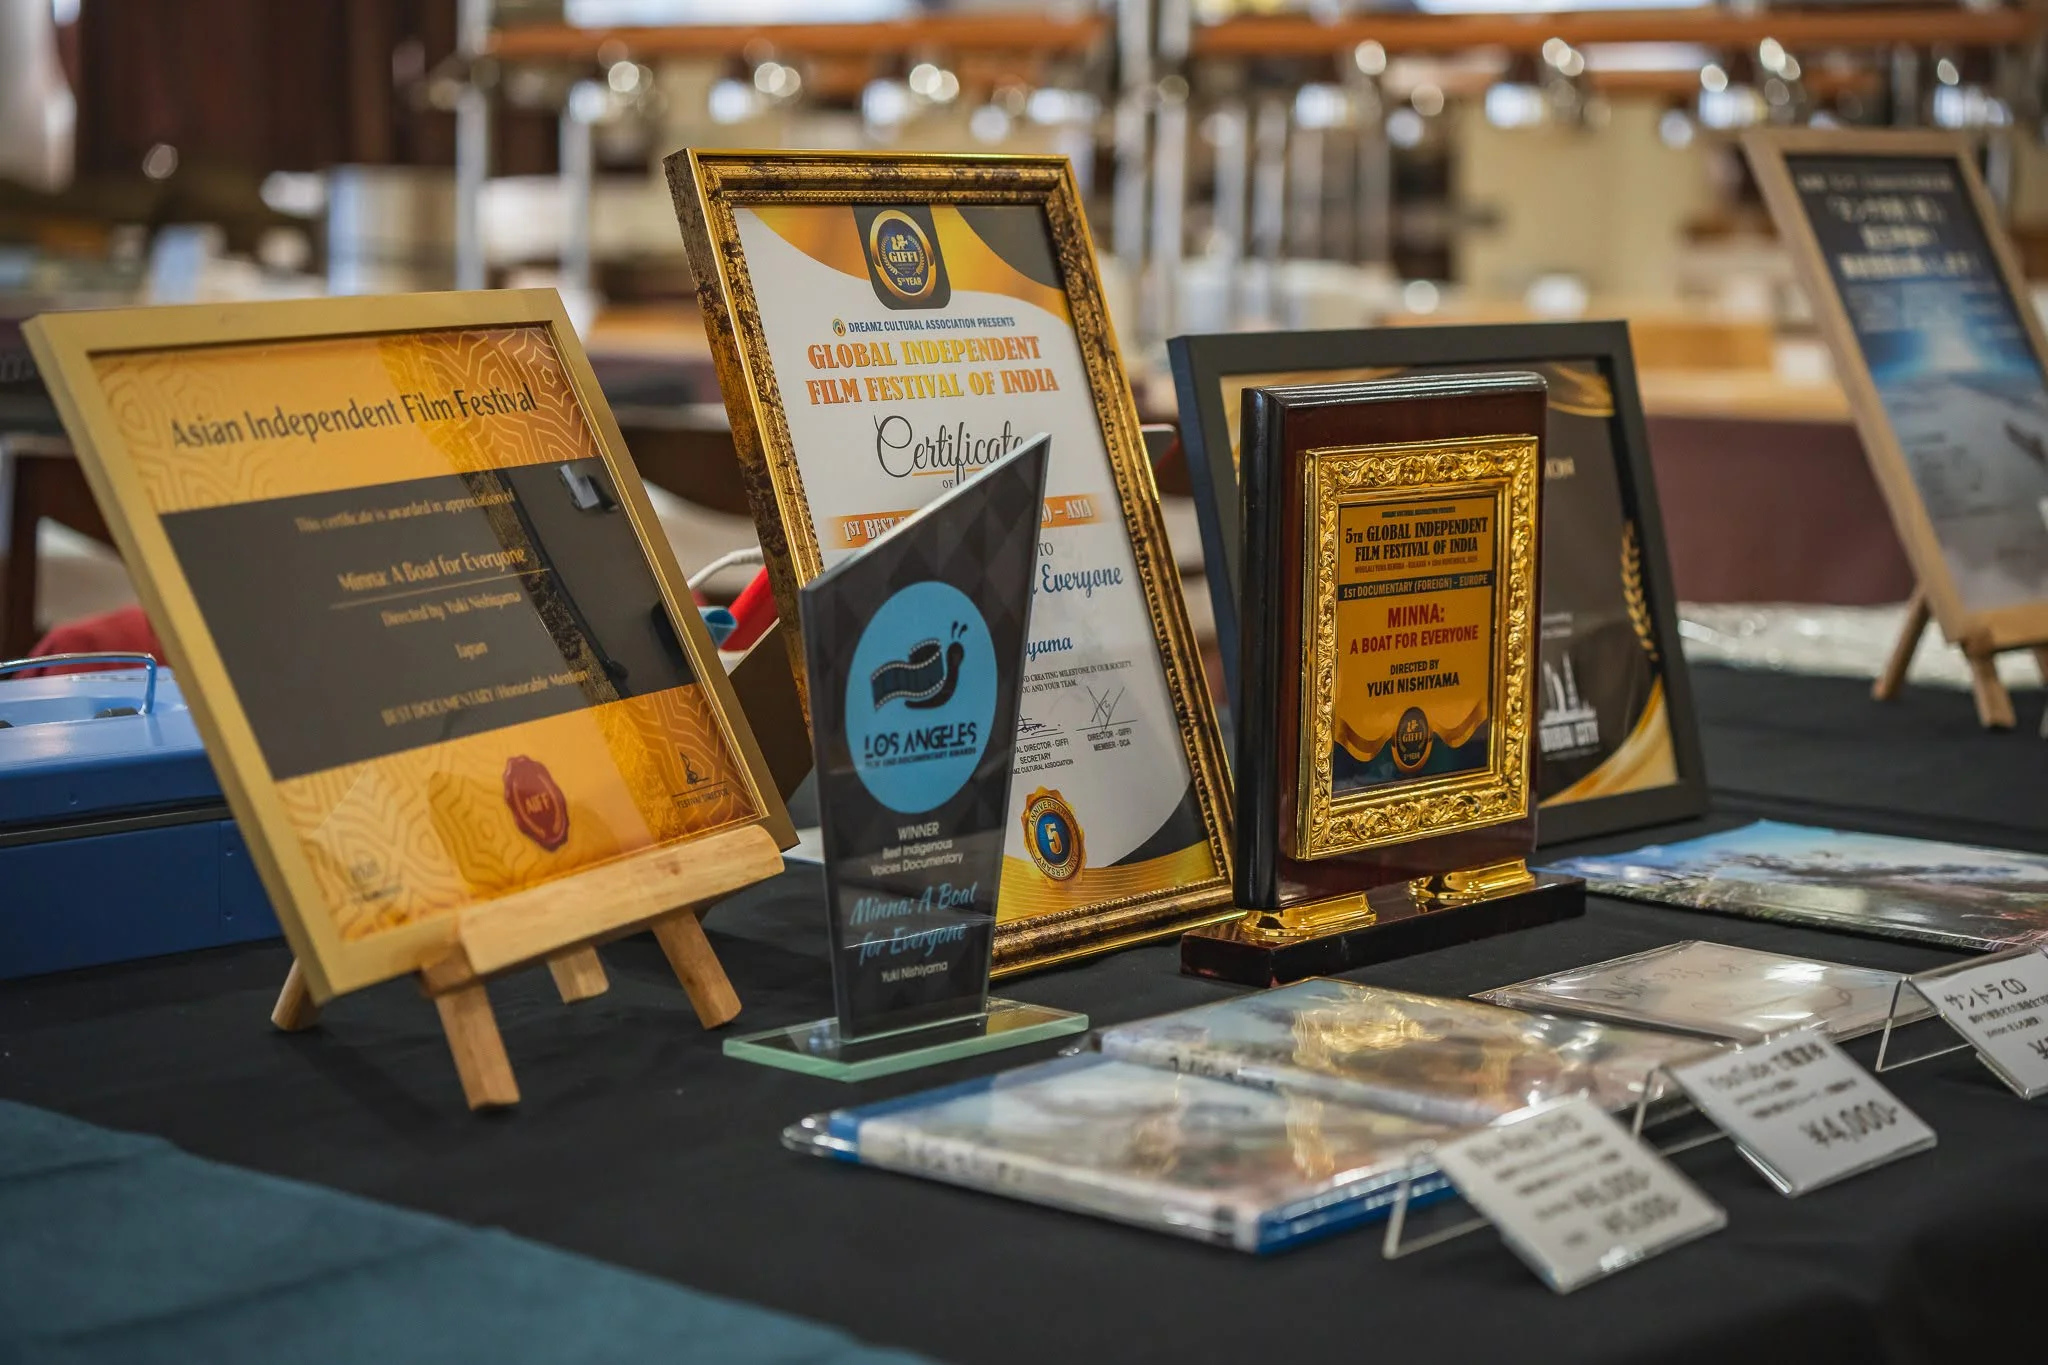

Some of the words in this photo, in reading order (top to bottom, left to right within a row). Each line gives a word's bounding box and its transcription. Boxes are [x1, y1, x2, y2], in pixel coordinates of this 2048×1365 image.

[888, 251, 919, 263] GIFFI
[905, 277, 922, 286] YEAR
[848, 321, 883, 333] DREAMZ
[884, 319, 925, 332] CULTURAL
[925, 317, 976, 330] ASSOCIATION
[977, 316, 1016, 328] PRESENTS
[807, 341, 897, 369] GLOBAL
[899, 335, 1041, 365] INDEPENDENT
[805, 377, 862, 405] FILM
[863, 372, 964, 401] FESTIVAL
[968, 371, 995, 395] OF
[999, 367, 1060, 393] INDIA
[172, 415, 244, 447] Asian
[244, 398, 401, 443] Independent
[401, 392, 455, 423] Film
[453, 382, 538, 418] Festival
[942, 480, 953, 488] OF
[1065, 499, 1093, 519] ASIA
[1345, 528, 1363, 544] 5TH
[1367, 523, 1411, 542] GLOBAL
[1415, 517, 1488, 538] INDEPENDENT
[1355, 545, 1380, 562] FILM
[1383, 541, 1430, 560] FESTIVAL
[1433, 540, 1447, 555] OF
[1450, 537, 1478, 553] INDIA
[391, 566, 404, 584] A
[438, 555, 461, 576] for
[461, 548, 525, 572] Everyone
[1042, 564, 1123, 598] Everyone
[1343, 587, 1357, 599] 1ST
[1357, 582, 1413, 597] DOCUMENTARY
[1414, 577, 1453, 593] (FOREIGN)
[1460, 573, 1488, 586] EUROPE
[1387, 603, 1445, 628] MINNA:
[1025, 637, 1073, 661] yama
[1350, 639, 1359, 654] A
[1361, 634, 1392, 653] BOAT
[1395, 632, 1418, 649] FOR
[1420, 625, 1479, 646] EVERYONE
[1030, 671, 1058, 682] CREATING
[1059, 666, 1089, 677] MILESTONE
[1089, 665, 1097, 674] IN
[1097, 664, 1109, 673] OUR
[1390, 661, 1428, 675] DIRECTED
[1429, 659, 1440, 670] BY
[1021, 685, 1031, 694] OU
[1031, 683, 1043, 693] AND
[1044, 681, 1060, 691] YOUR
[1367, 681, 1394, 697] YUKI
[1397, 672, 1460, 693] NISHIYAMA
[865, 732, 899, 758] LOS
[904, 722, 976, 754] ANGELES
[1023, 740, 1052, 753] DIRECTOR
[1054, 738, 1069, 748] GIFFI
[1087, 731, 1113, 741] DIRECTOR
[1093, 741, 1116, 751] MEMBER
[1019, 752, 1051, 764] SECRETARY
[1021, 763, 1044, 774] CULTURAL
[1044, 759, 1074, 769] ASSOCIATION
[898, 821, 940, 841] WINNER
[1045, 822, 1062, 854] 5
[882, 847, 902, 860] Best
[903, 839, 953, 857] Indigenous
[871, 863, 901, 877] Voices
[902, 852, 964, 872] Documentary
[849, 896, 914, 926] Minna:
[917, 885, 933, 914] A
[859, 930, 886, 966] for
[891, 923, 967, 957] Everyone
[881, 970, 900, 983] Yuki
[901, 961, 948, 980] Nishiyama
